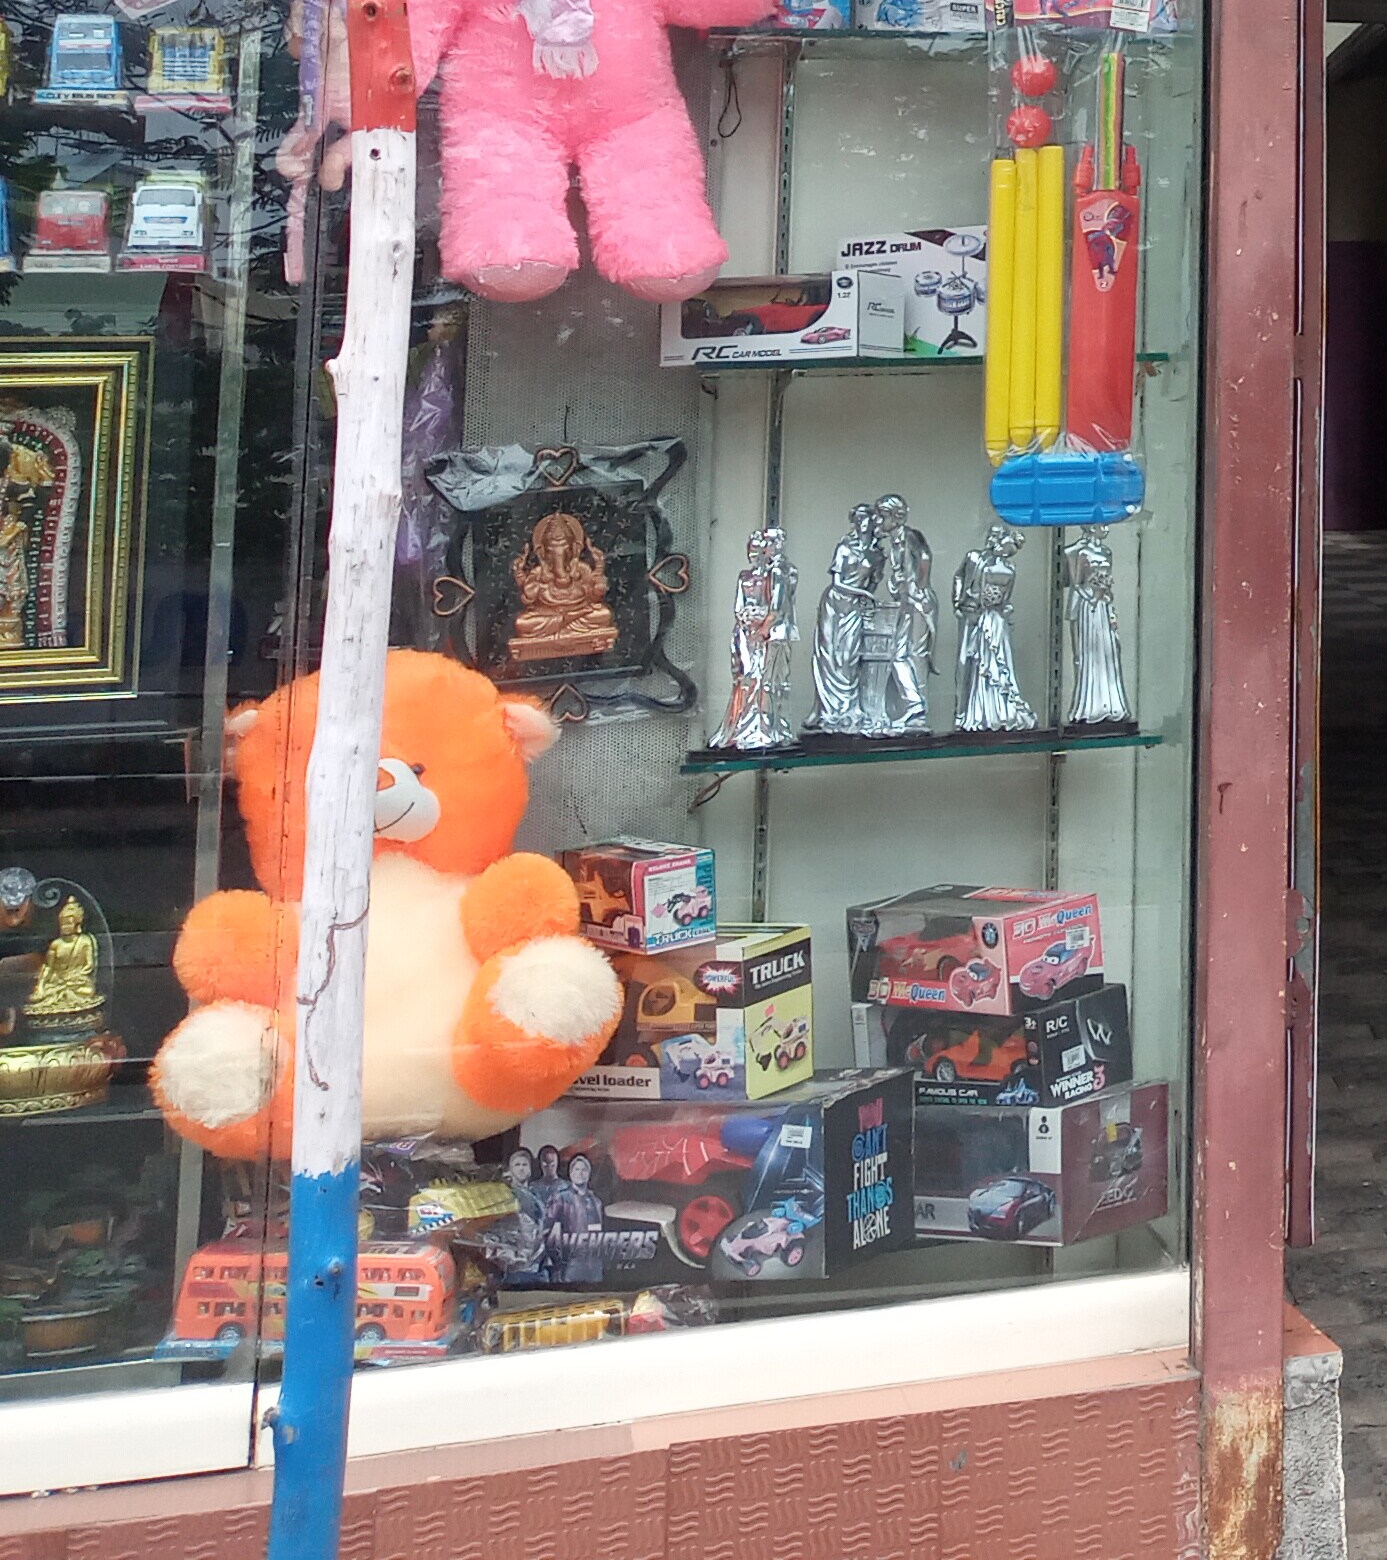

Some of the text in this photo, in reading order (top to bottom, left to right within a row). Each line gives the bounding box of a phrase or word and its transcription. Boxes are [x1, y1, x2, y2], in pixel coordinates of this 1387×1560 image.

[841, 241, 922, 257] JAZZ DRUM
[691, 344, 738, 360] RC
[752, 348, 782, 357] MODEL
[750, 951, 805, 984] TRUCK
[1046, 1016, 1068, 1032] R/C
[603, 1075, 651, 1088] loader
[918, 1087, 957, 1096] FAMOUS
[1050, 1072, 1094, 1097] WINNER
[853, 1153, 888, 1189] FIGHT
[847, 1176, 893, 1223] THANOS
[549, 1222, 659, 1260] AVENGERS
[853, 1207, 891, 1250] ALONE
